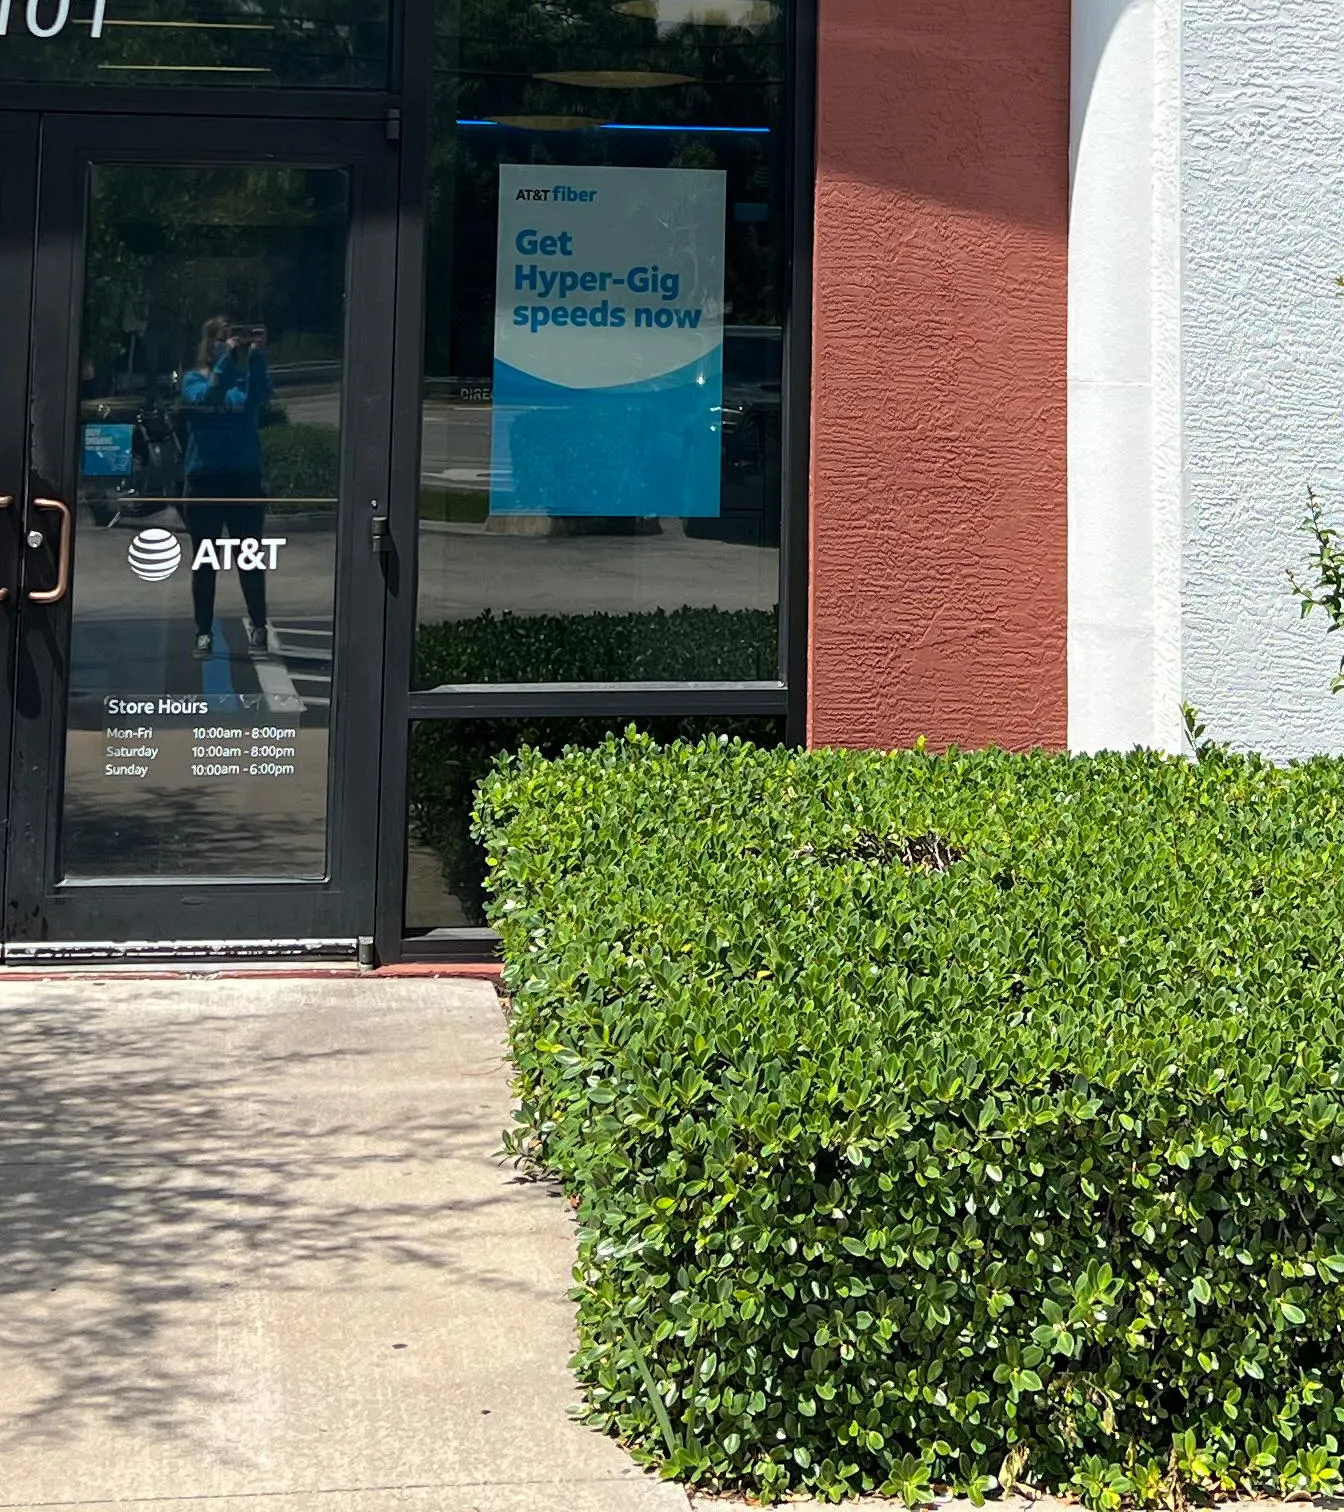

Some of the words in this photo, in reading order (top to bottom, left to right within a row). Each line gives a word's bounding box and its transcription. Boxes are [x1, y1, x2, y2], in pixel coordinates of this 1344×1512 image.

[515, 188, 550, 202] AT&T
[552, 186, 597, 203] fiber
[515, 229, 573, 256] Get
[514, 264, 680, 300] Hyper-Gig
[513, 300, 626, 333] speeds
[634, 307, 702, 330] now
[460, 388, 494, 401] DIRE
[191, 538, 286, 571] AT&T
[108, 699, 155, 715] Store
[158, 699, 209, 715] Hours
[106, 726, 153, 740] Mon-Fri
[192, 726, 242, 740] 10:00am
[251, 727, 296, 742] 8:00pm
[106, 745, 159, 760] Saturday
[191, 745, 242, 758] 10:00am
[250, 745, 295, 760] 8:00pm
[105, 763, 149, 778] Sunday
[190, 763, 240, 777] 10:00am
[249, 763, 294, 779] 6:00pm
